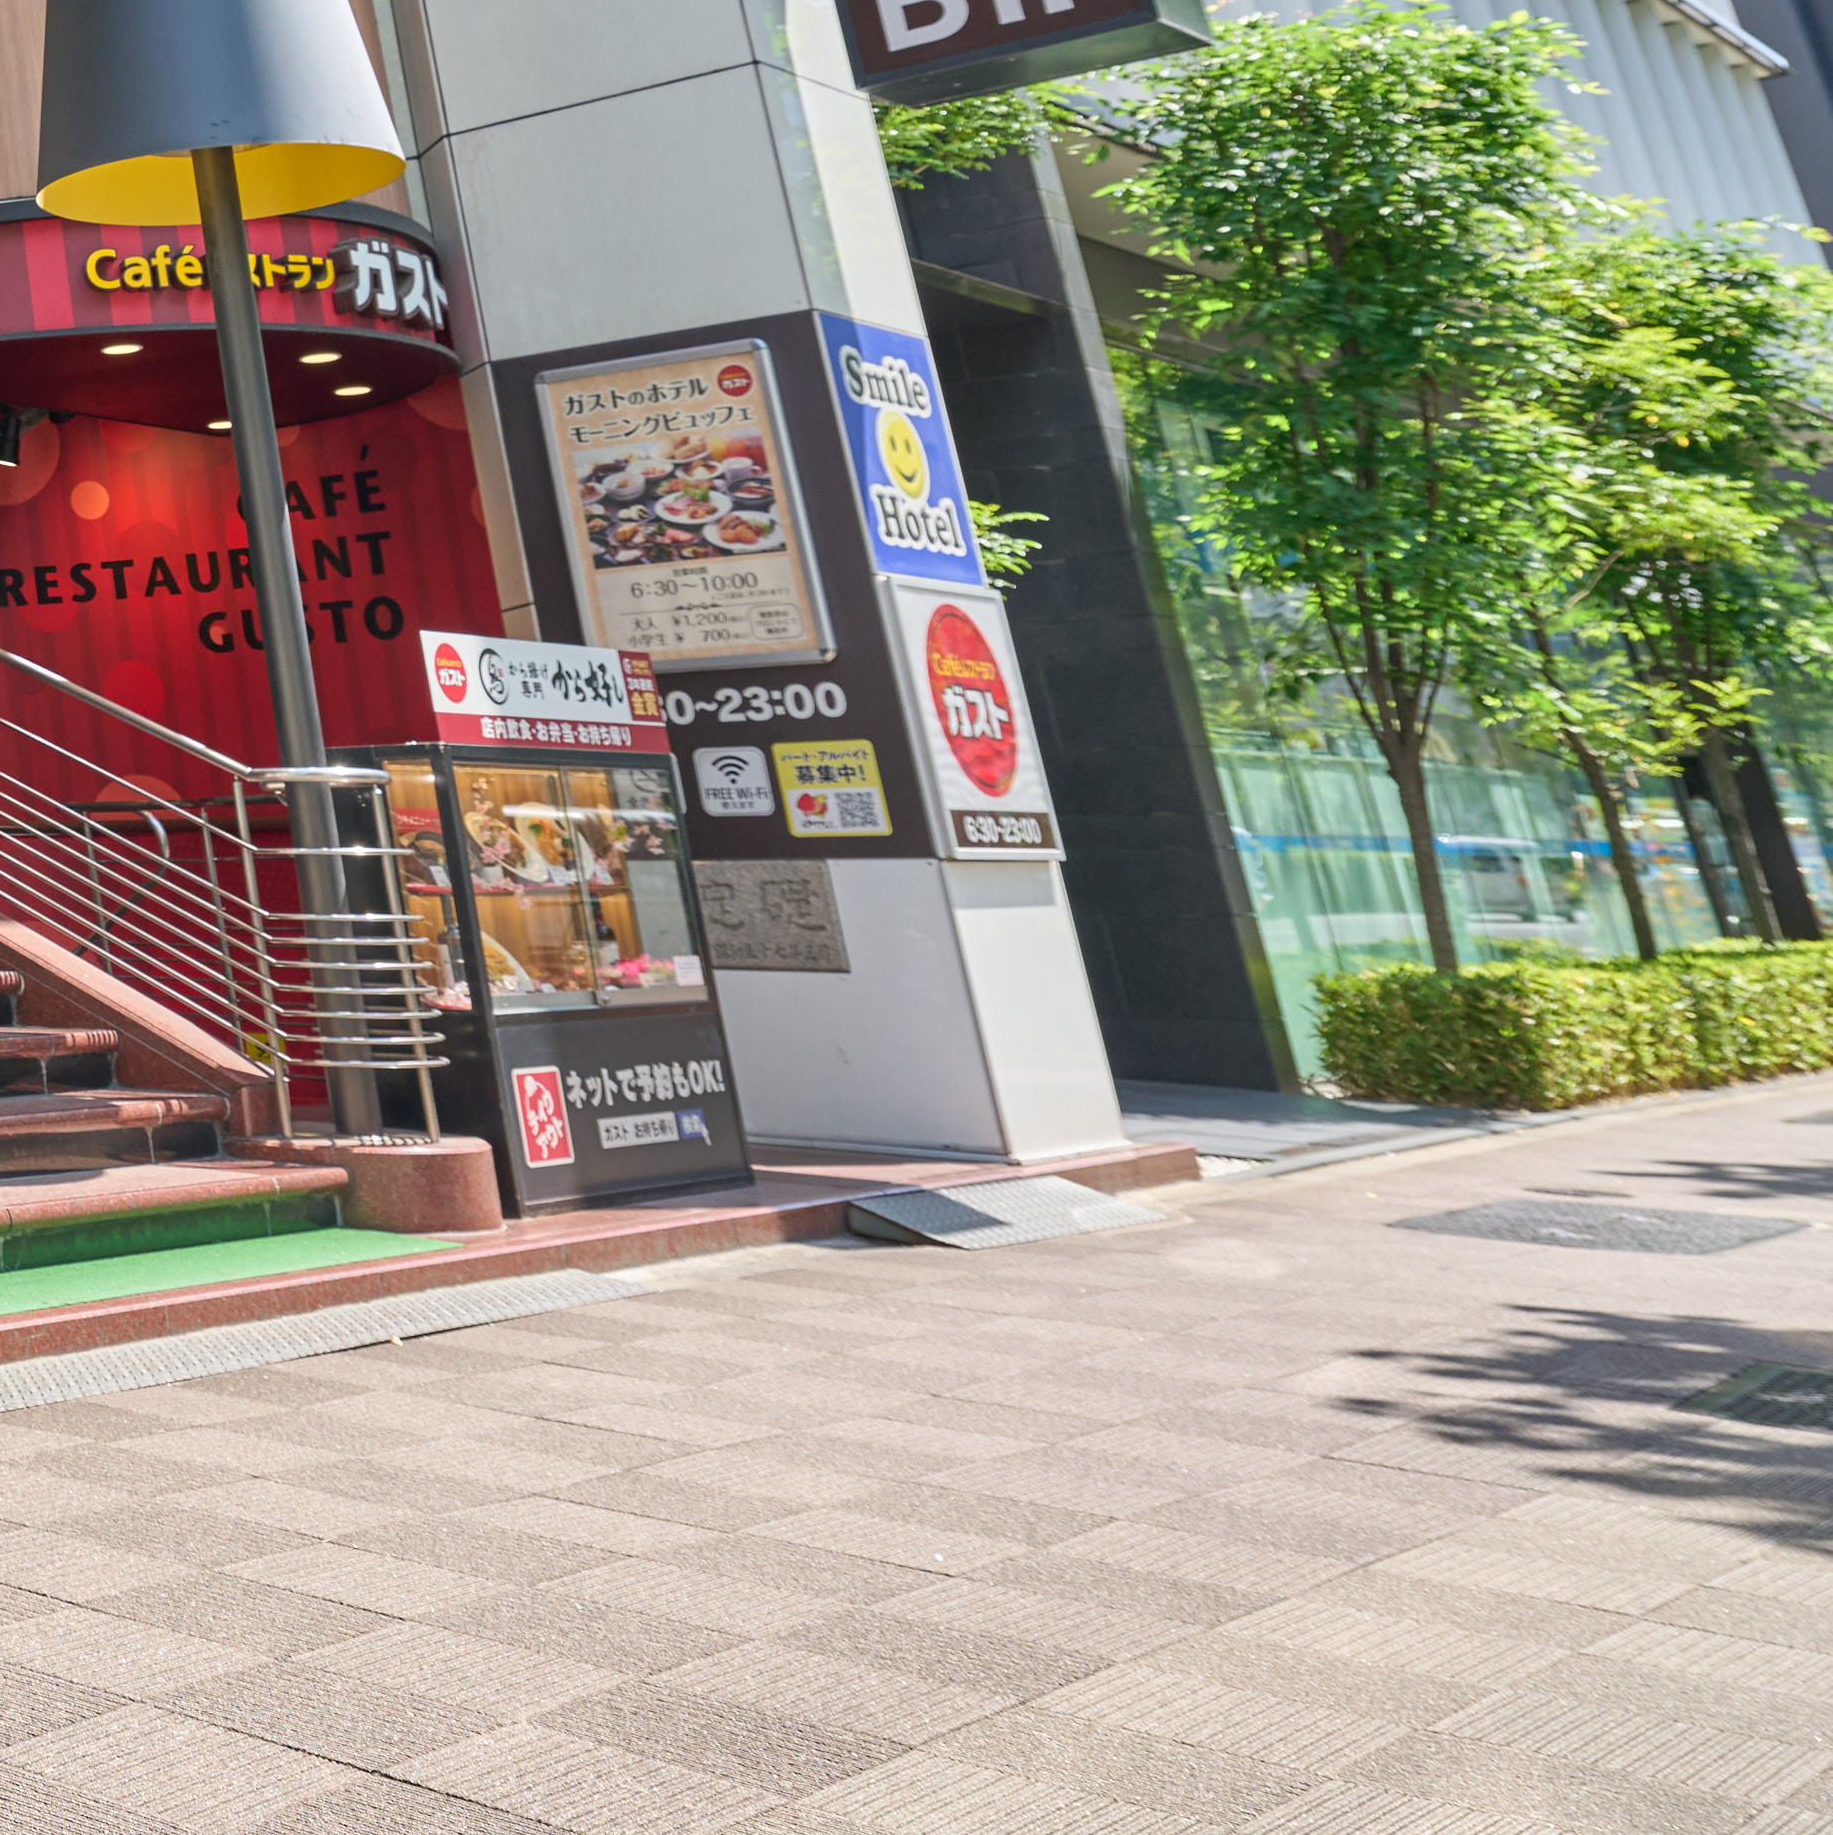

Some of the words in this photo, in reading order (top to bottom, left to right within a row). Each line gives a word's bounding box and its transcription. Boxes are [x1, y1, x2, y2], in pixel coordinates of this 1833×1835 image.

[86, 244, 204, 290] Café
[247, 253, 335, 290] ストラン
[349, 240, 448, 326] ガスト
[564, 378, 709, 416] ガストのホテル
[842, 350, 929, 414] Smile
[569, 405, 755, 444] モーニングビュッフェ
[237, 445, 386, 522] AFÉ
[874, 491, 962, 551] Hotel
[198, 596, 405, 654] GUTO
[633, 617, 659, 631] 大人
[701, 628, 732, 642] 700
[438, 668, 466, 688] ガスト
[659, 681, 848, 726] 0~23:00
[942, 684, 1010, 740] ガスト
[705, 787, 734, 800] FREE
[735, 787, 769, 800] Wi-Fi
[603, 1124, 629, 1142] ガスト
